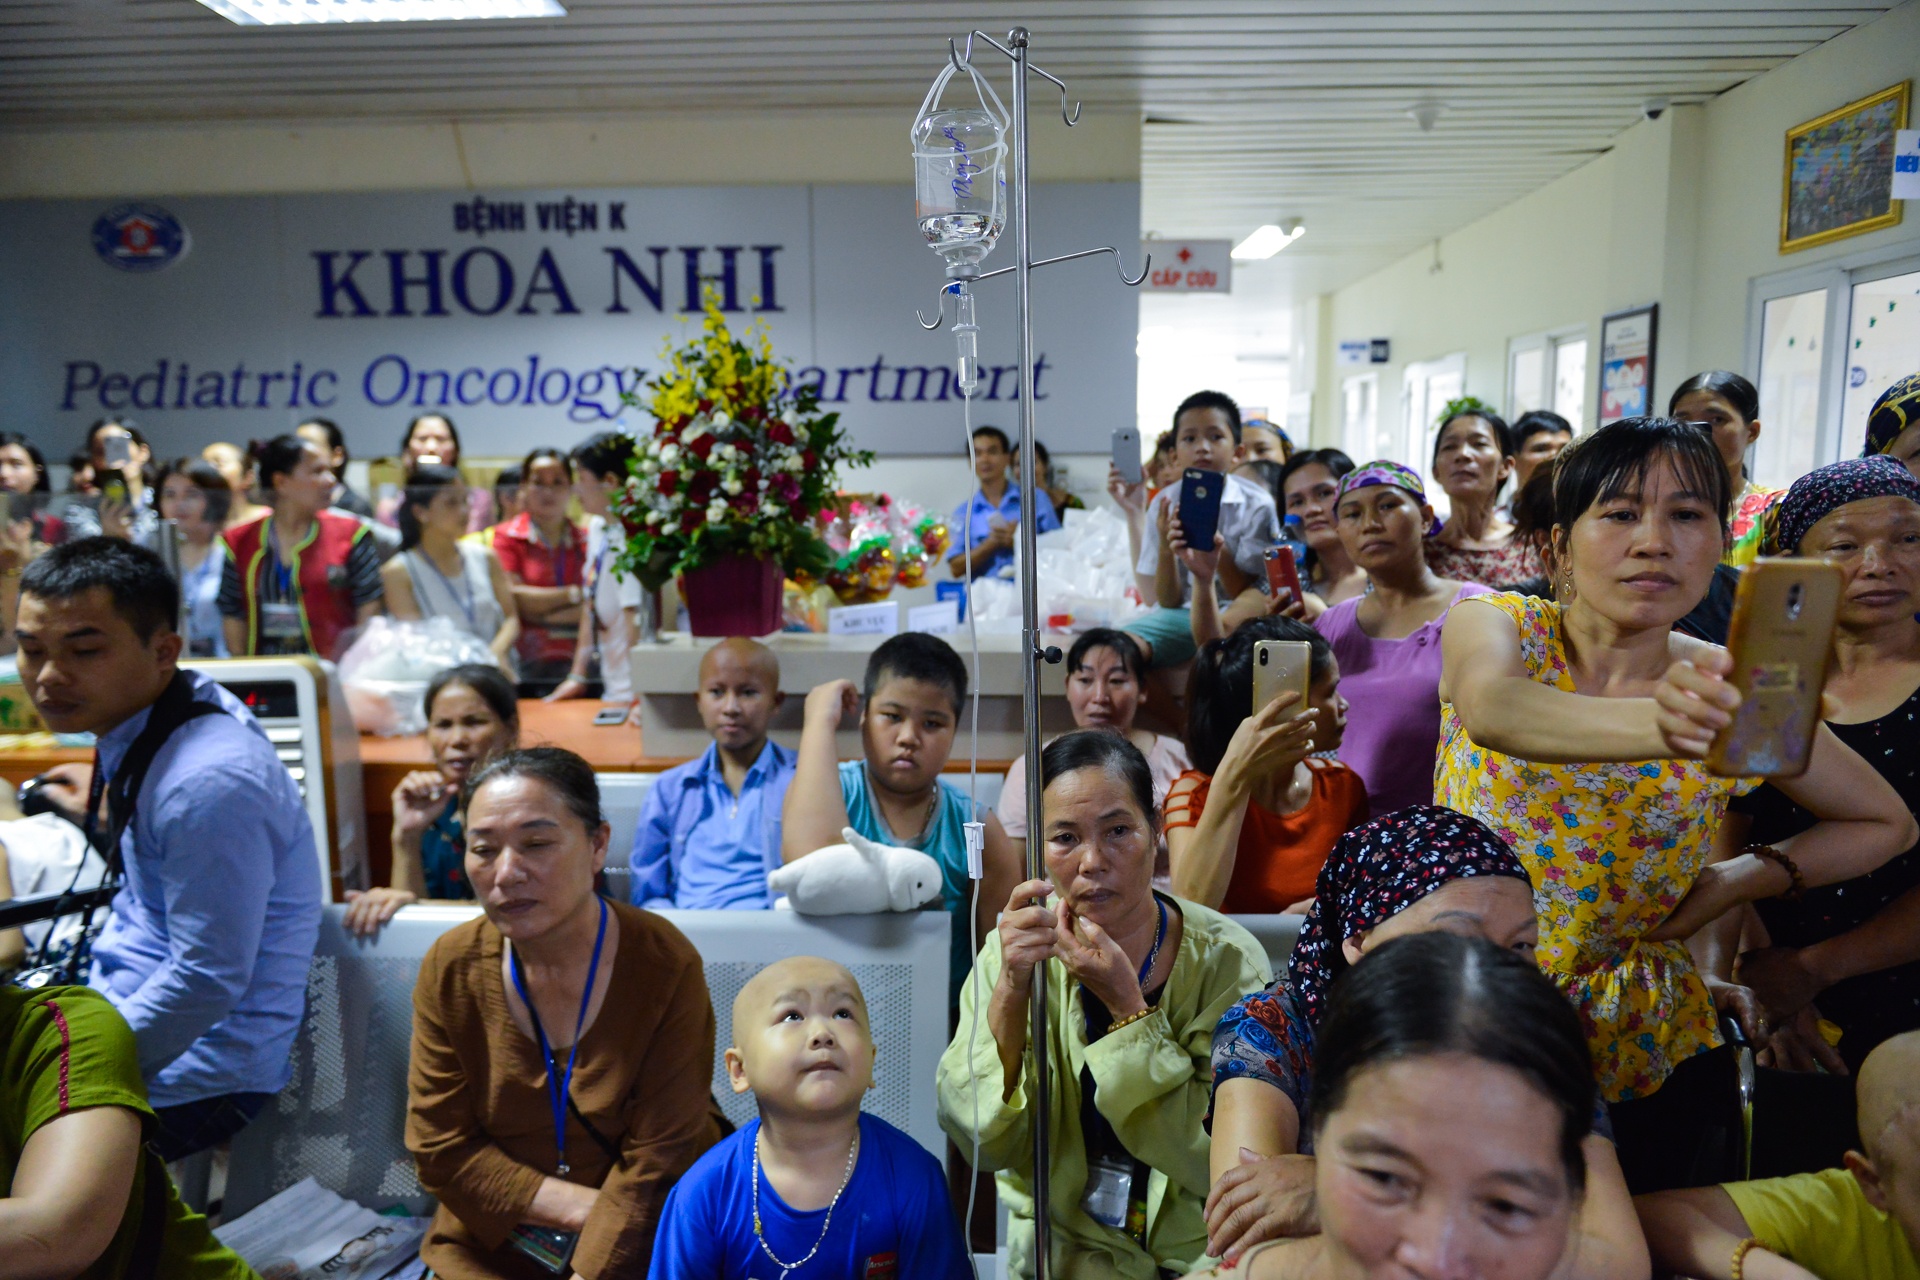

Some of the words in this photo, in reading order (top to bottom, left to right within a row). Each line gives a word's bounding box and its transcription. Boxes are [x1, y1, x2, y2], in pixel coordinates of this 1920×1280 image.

[454, 196, 525, 237] BỆNH
[535, 196, 597, 237] VIỆN
[609, 202, 627, 231] K
[311, 246, 582, 318] KHOA
[602, 244, 786, 315] NHI
[60, 358, 337, 411] Pediatric
[362, 352, 648, 424] Oncology
[772, 352, 1052, 404] artment
